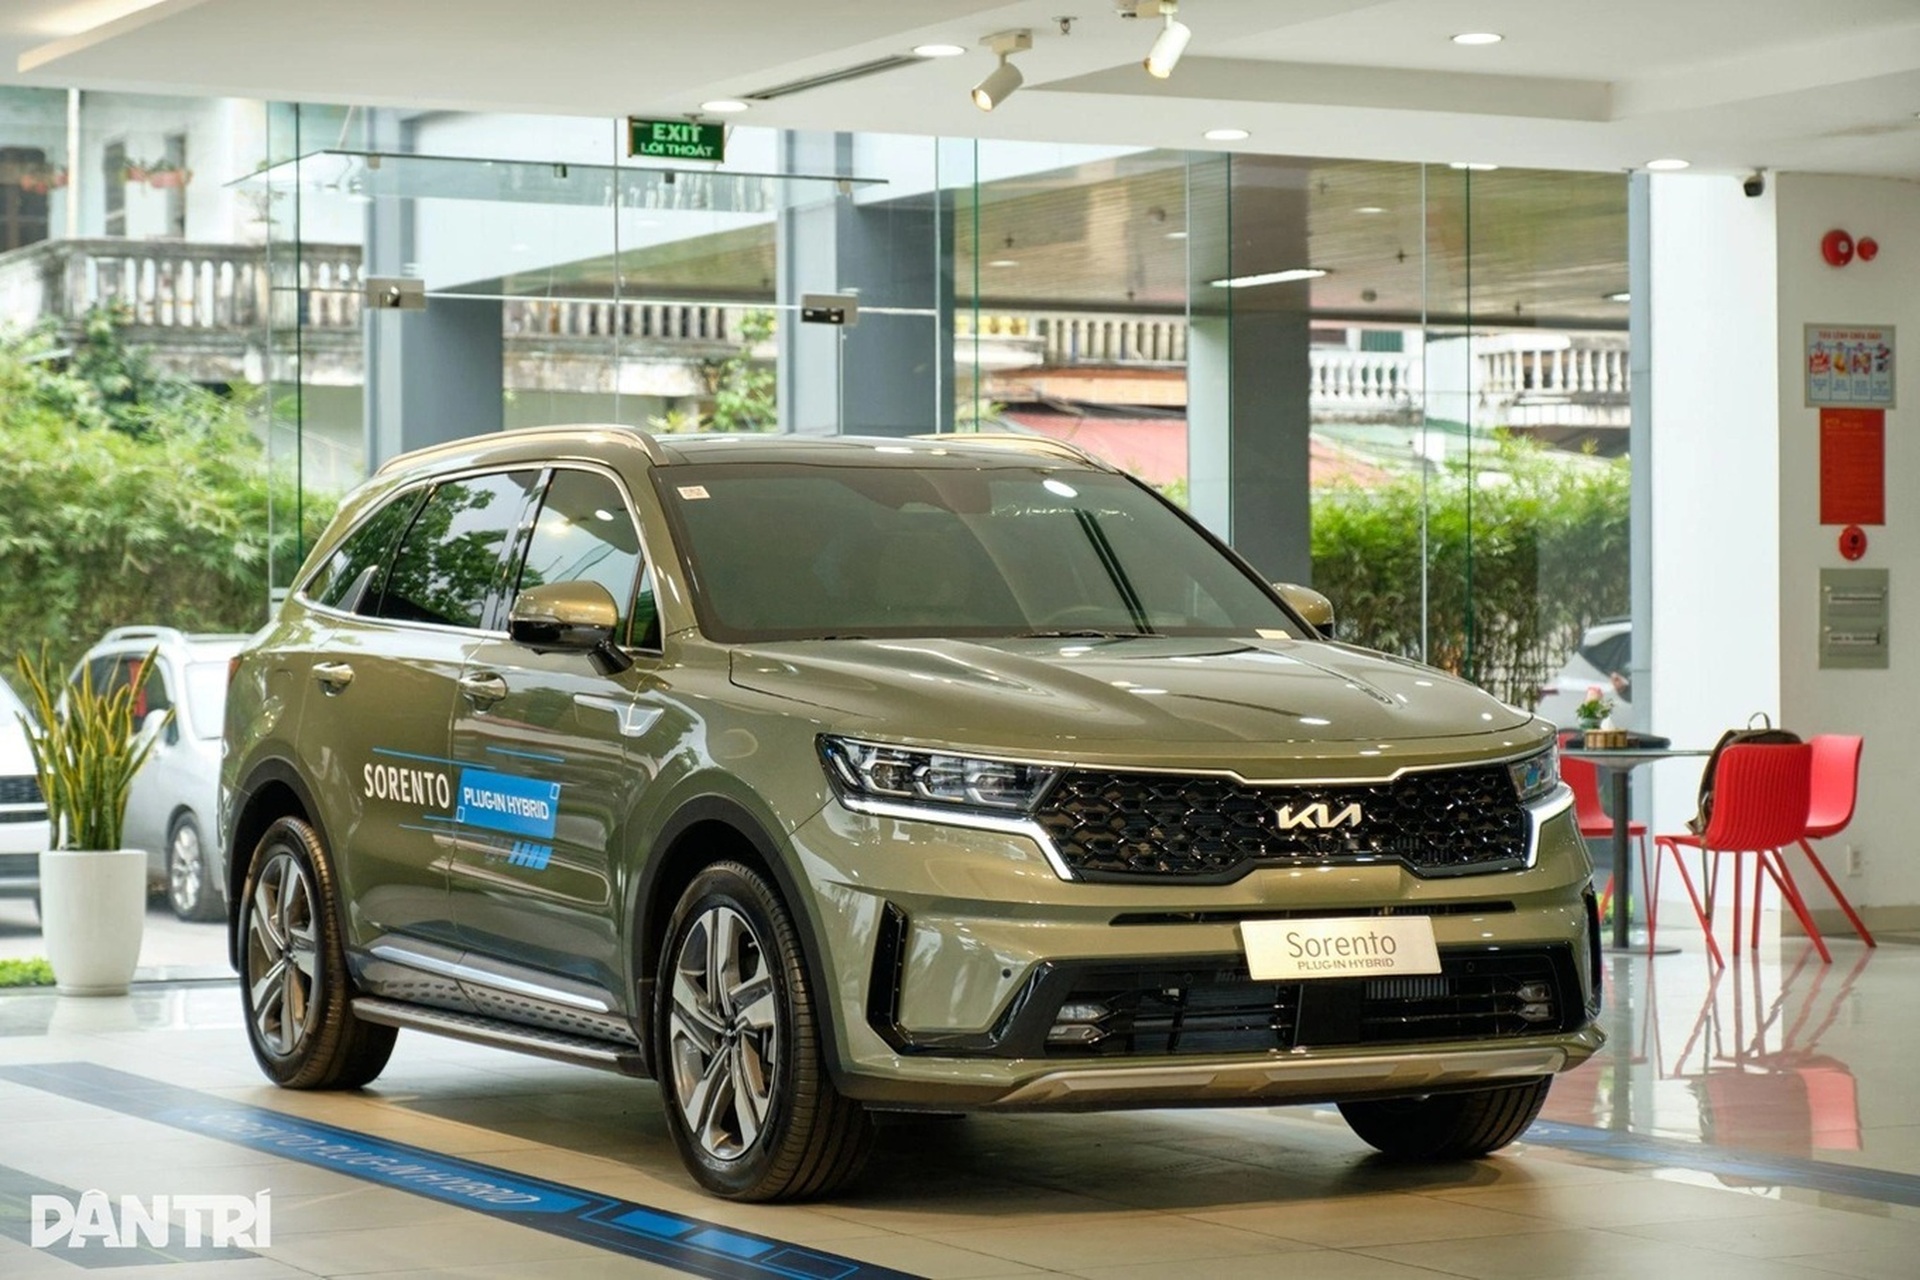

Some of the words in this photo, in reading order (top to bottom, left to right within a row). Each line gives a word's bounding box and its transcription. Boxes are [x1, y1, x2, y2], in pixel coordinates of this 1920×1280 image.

[653, 123, 703, 142] EXIT
[364, 763, 450, 809] SORENTO
[463, 787, 506, 812] PLUG-IN
[507, 794, 549, 820] HYBRID
[1278, 803, 1362, 829] KIA
[1286, 931, 1396, 958] Sorento
[1297, 960, 1346, 971] PLUG-IN
[1349, 957, 1395, 969] HYBRID
